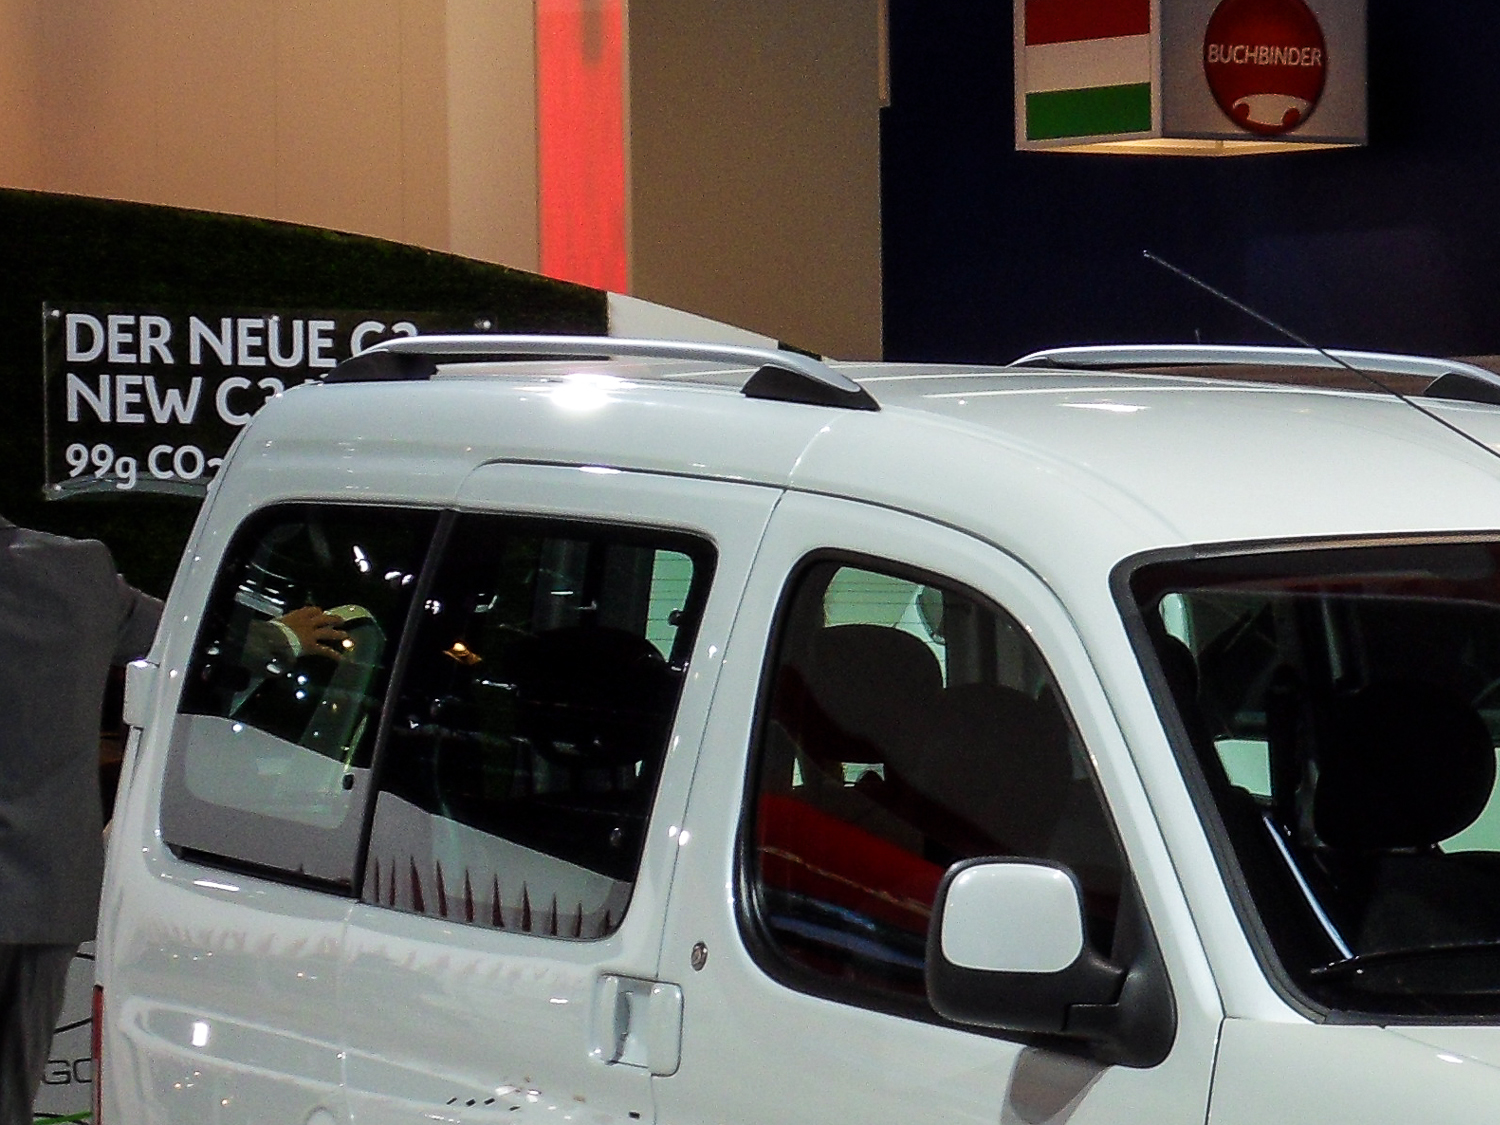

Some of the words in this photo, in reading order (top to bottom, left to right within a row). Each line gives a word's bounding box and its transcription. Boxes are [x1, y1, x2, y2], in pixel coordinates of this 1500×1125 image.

[1207, 43, 1322, 66] BUCHBINDER
[66, 313, 173, 364] DER
[190, 316, 337, 368] NEUE
[66, 373, 202, 424] NEW
[66, 443, 138, 490] 99g
